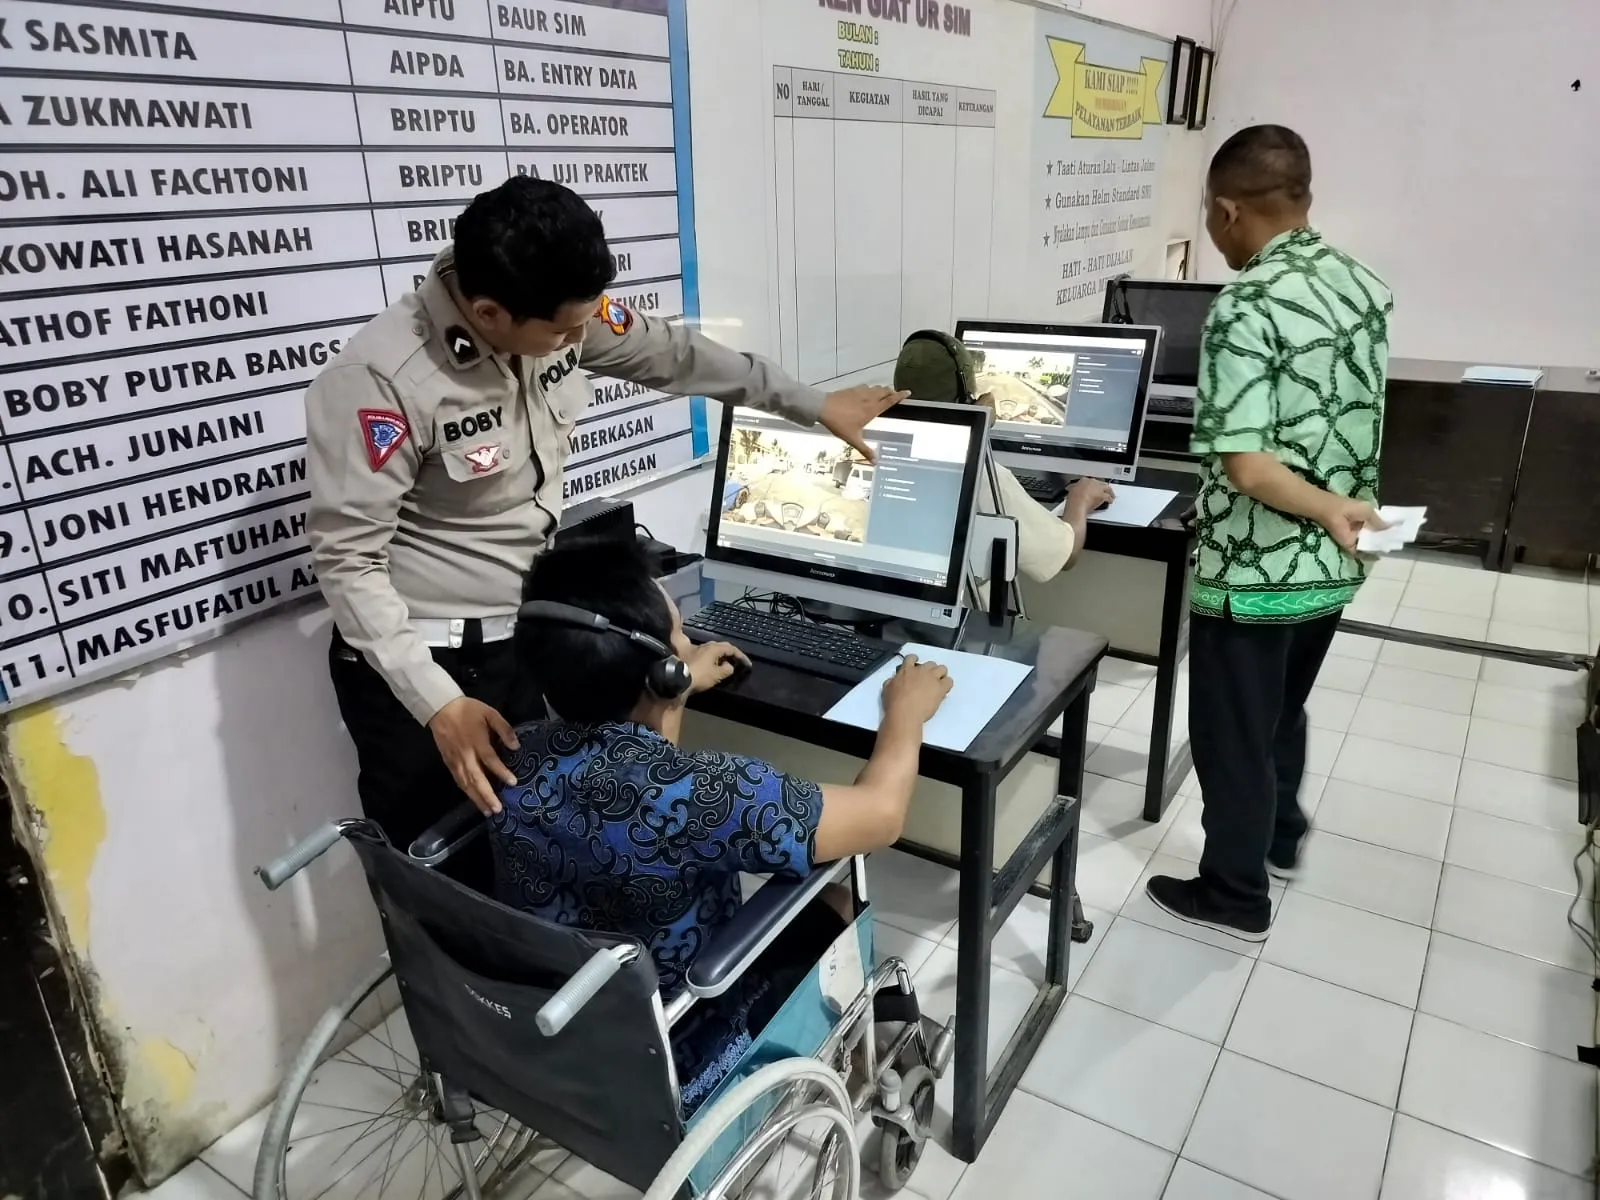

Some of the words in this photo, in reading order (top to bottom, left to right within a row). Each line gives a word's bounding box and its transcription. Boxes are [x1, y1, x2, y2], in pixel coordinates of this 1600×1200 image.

[498, 5, 549, 32] BAUR
[554, 12, 587, 37] SIM
[837, 20, 873, 44] BULAN
[916, 0, 940, 30] UR
[943, 3, 971, 37] SIM
[25, 19, 198, 61] SASMITA
[390, 49, 465, 78] AIPDA
[504, 59, 536, 83] BA.
[541, 62, 593, 87] ENTRY
[599, 68, 638, 90] DATA
[838, 49, 874, 72] TAHUN
[776, 82, 790, 100] NO
[802, 80, 820, 93] HARI
[912, 89, 930, 101] HASIL
[1084, 69, 1106, 91] KAMI
[1106, 72, 1125, 93] SIAP
[21, 95, 253, 130] ZUKMAWATI
[797, 95, 830, 108] TANGGAL
[849, 91, 890, 106] KEGIATAN
[390, 107, 476, 133] BRIPTU
[510, 112, 542, 135] BA.
[547, 114, 629, 137] OPERATOR
[82, 168, 138, 199] ALI
[150, 166, 309, 196] FACHTONI
[399, 163, 483, 188] BRIPTU
[552, 163, 579, 184] UJI
[583, 163, 649, 184] PRAKTEK
[1057, 160, 1077, 175] Taati
[1055, 191, 1090, 209] Gunakan
[1091, 188, 1110, 206] Helm
[157, 226, 313, 263] HASANAH
[1062, 260, 1081, 279] HATI
[126, 290, 269, 332] FATHONI
[3, 375, 110, 418] BOBY
[126, 357, 237, 397] PUTRA
[443, 406, 503, 442] BOBY
[26, 444, 114, 484] ACH.
[127, 411, 266, 462] JUNAINI
[562, 453, 657, 499] EMBERKASAN
[43, 501, 131, 548] JONI
[58, 566, 127, 607] SITI
[140, 512, 308, 584] MAFTUHAH
[77, 576, 281, 665] MASFUFATUL
[2, 653, 65, 689] 11.
